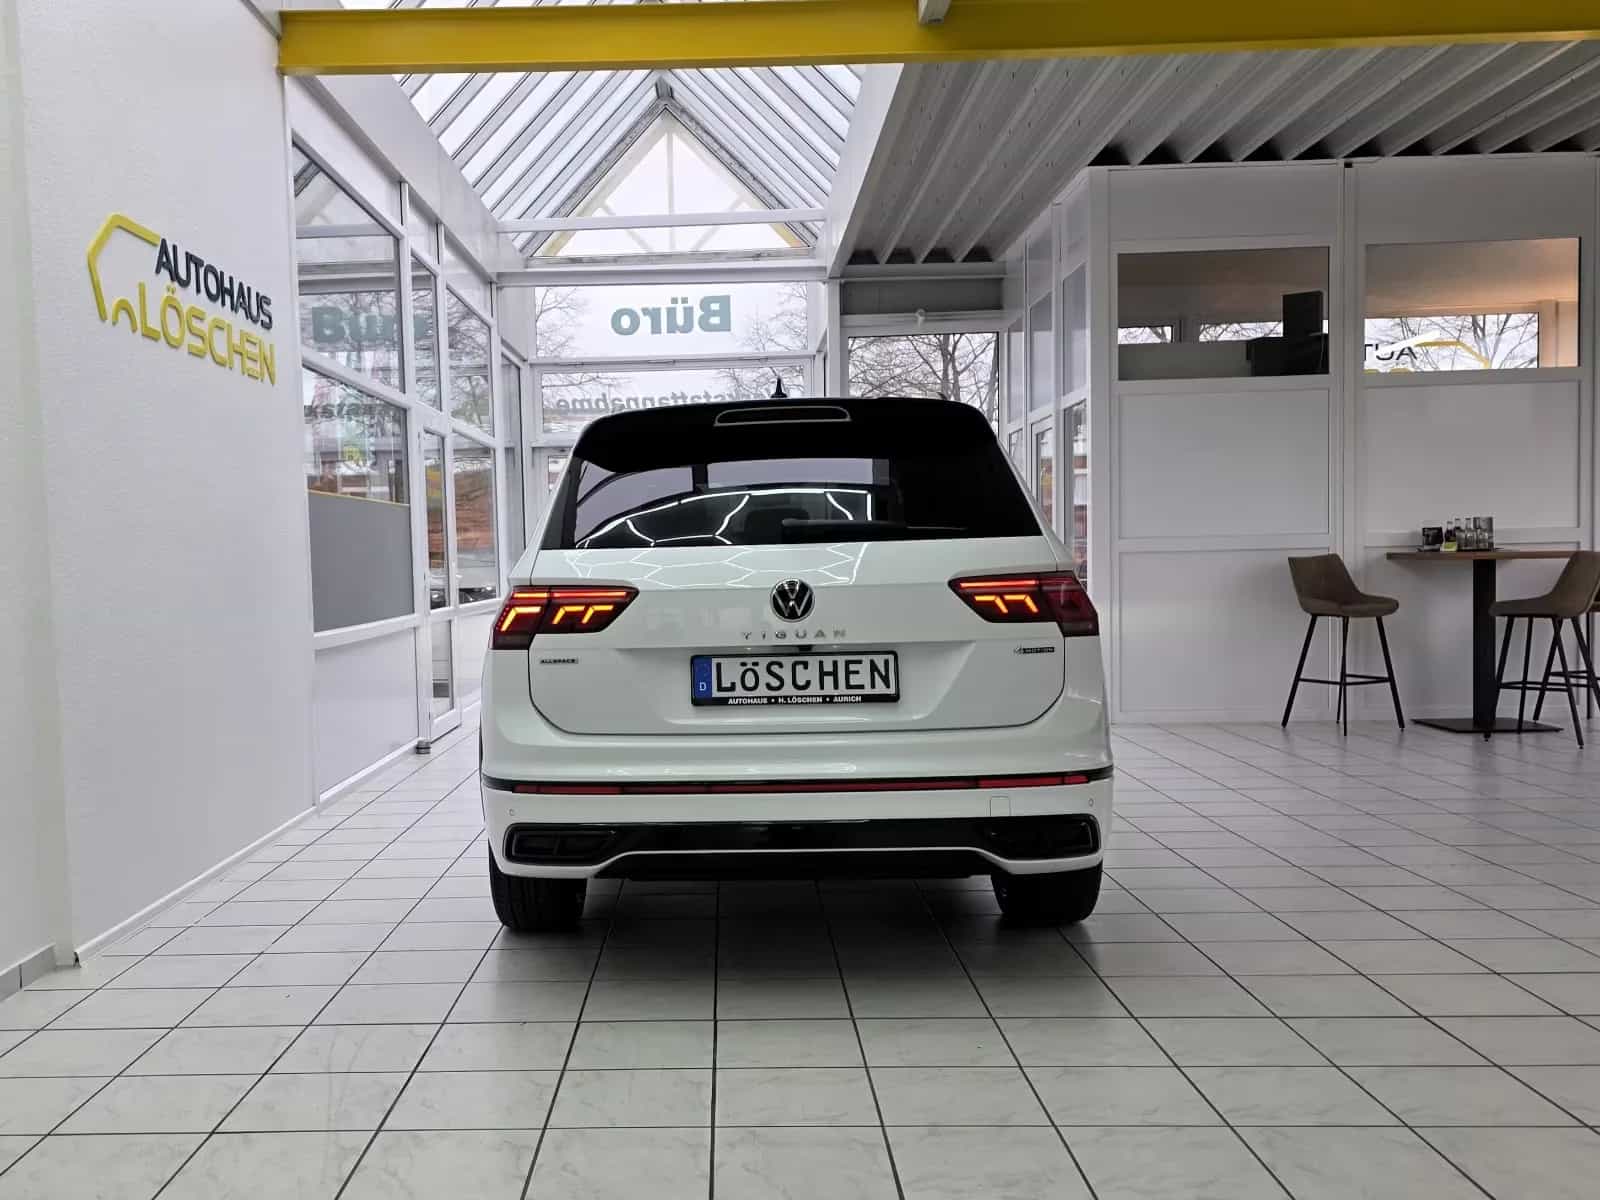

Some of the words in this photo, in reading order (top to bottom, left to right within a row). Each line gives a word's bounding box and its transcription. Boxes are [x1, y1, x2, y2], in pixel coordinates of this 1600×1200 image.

[155, 238, 273, 330] AUTOHAUS
[138, 281, 276, 385] LÖSCHEN
[742, 629, 847, 640] TIGUAN
[699, 682, 707, 691] D
[715, 659, 891, 693] LÖSCHEN
[727, 696, 768, 705] AUTOHAUS
[788, 694, 822, 704] LÖSCHEN
[832, 695, 862, 703] AURICH
